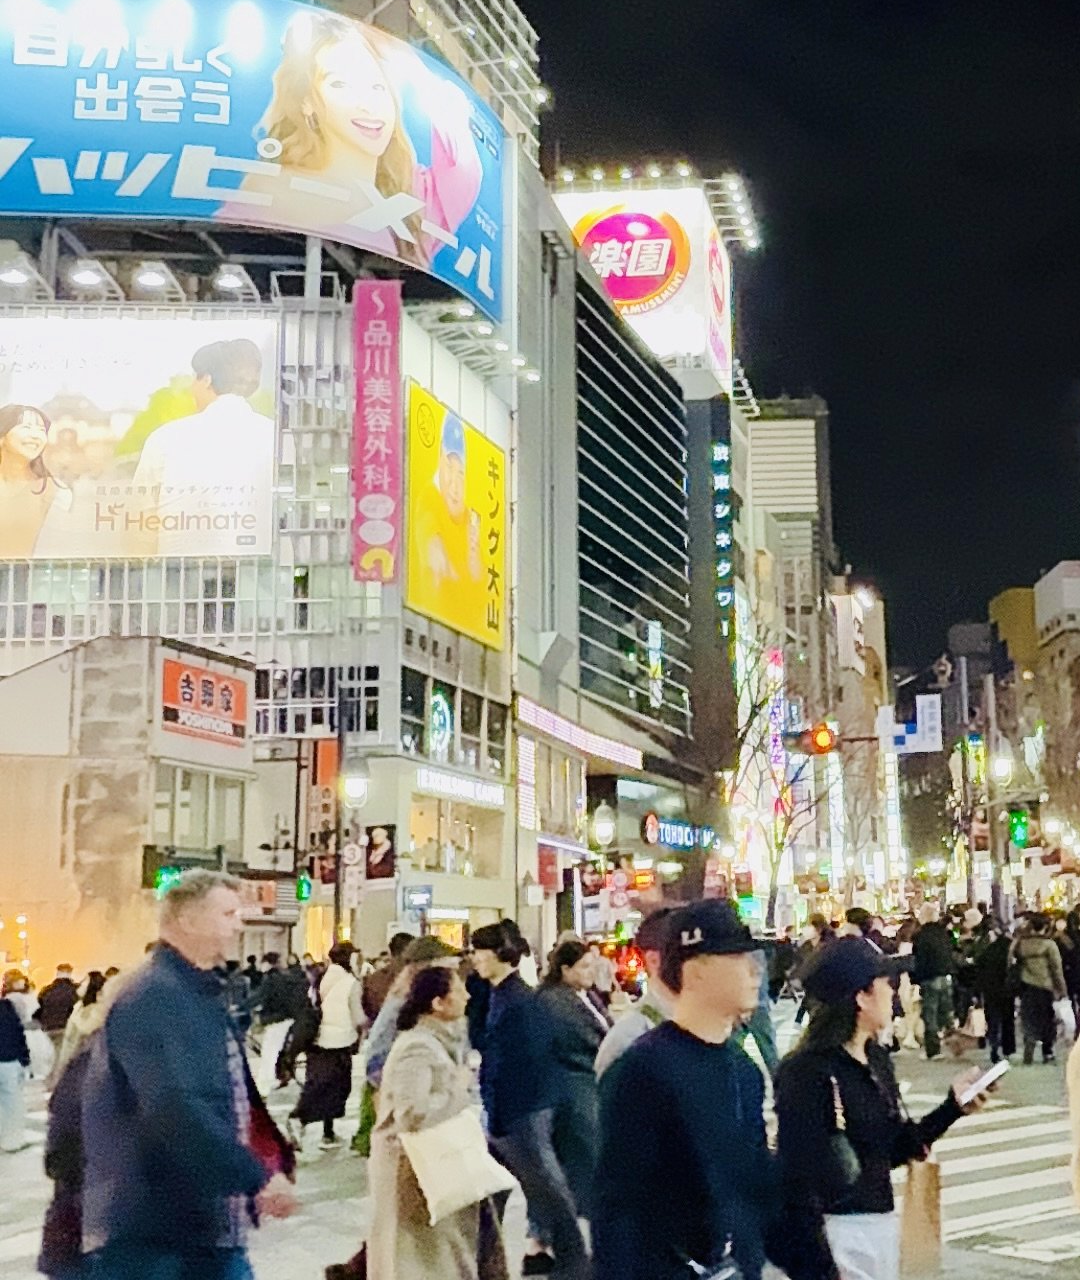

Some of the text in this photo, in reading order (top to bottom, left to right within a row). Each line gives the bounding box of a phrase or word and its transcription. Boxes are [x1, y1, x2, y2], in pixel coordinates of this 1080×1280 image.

[73, 72, 231, 125] 出会う
[0, 136, 497, 302] ハッピーメール
[588, 237, 672, 278] 楽園
[619, 271, 686, 315] AMUSEMENT
[362, 318, 393, 492] 品川美容外科
[124, 510, 257, 532] Healmate
